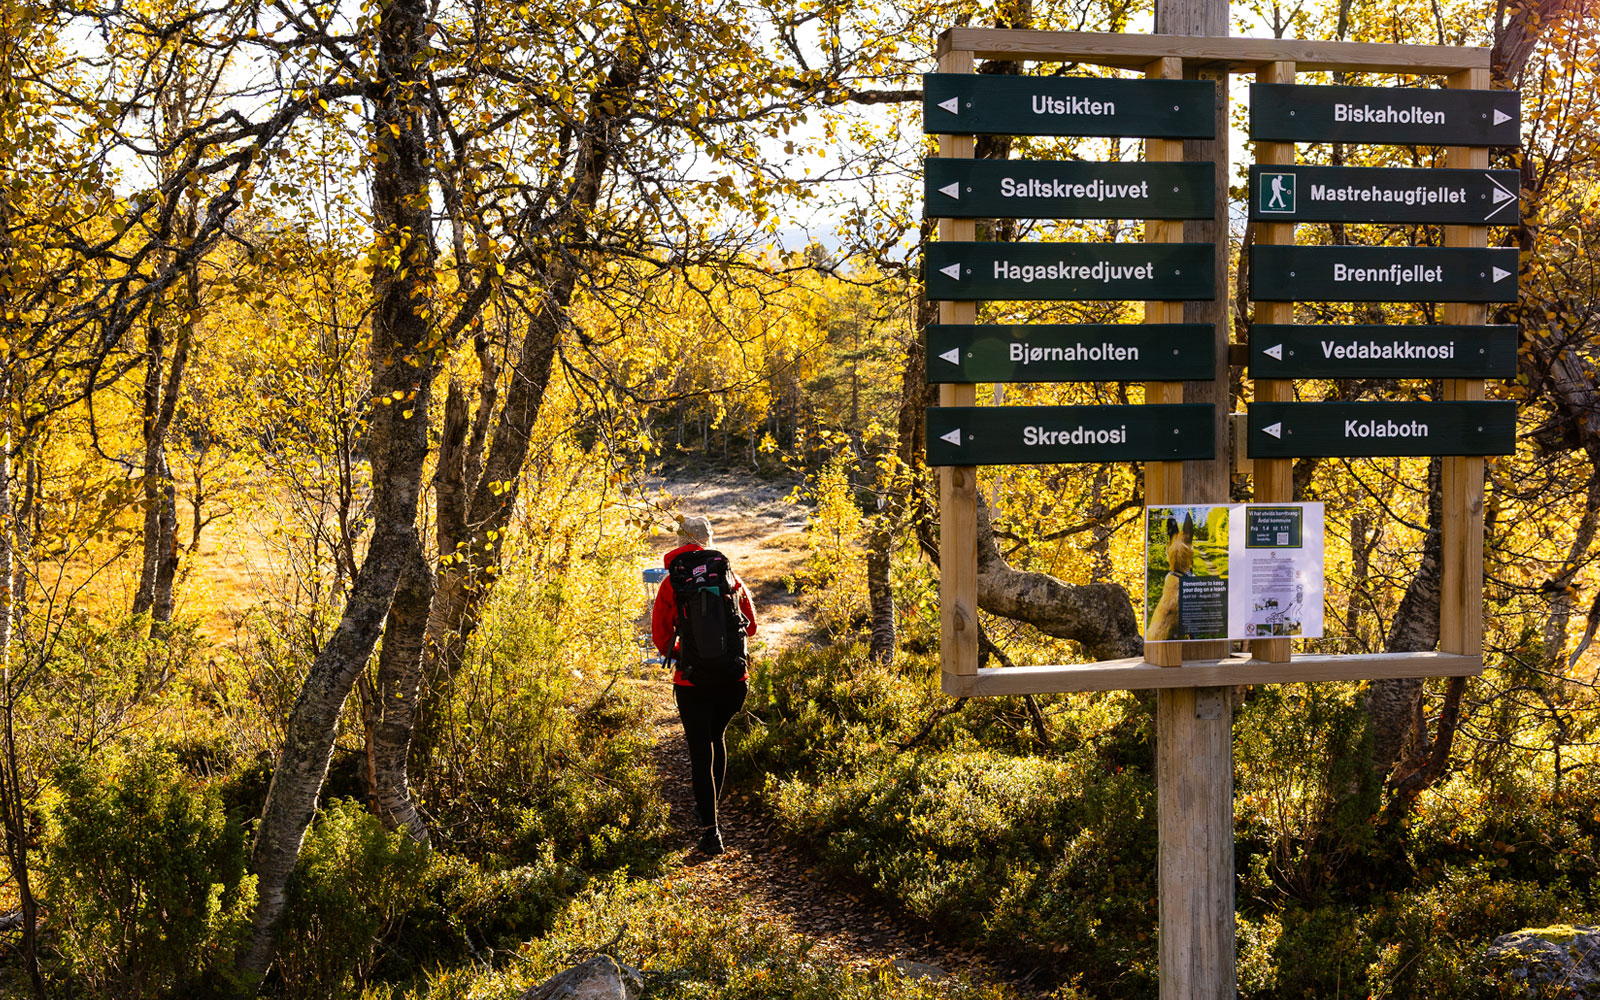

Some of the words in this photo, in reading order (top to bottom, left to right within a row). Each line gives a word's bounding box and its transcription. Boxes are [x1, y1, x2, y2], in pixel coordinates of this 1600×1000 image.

[1032, 94, 1115, 116] Utsikten
[1334, 103, 1446, 125] Biskaholten
[1000, 177, 1149, 202] Saltskredjuvet
[1310, 184, 1467, 206] Mastrehaugfjellet
[993, 259, 1154, 283] Hagaskredjuvet
[1334, 263, 1443, 286] Brennfjellet
[1009, 342, 1139, 365] Bjørnaholten
[1321, 340, 1455, 360] Vedabakknosi
[1023, 424, 1127, 446] Skrednosi
[1344, 419, 1429, 438] Kolabotn
